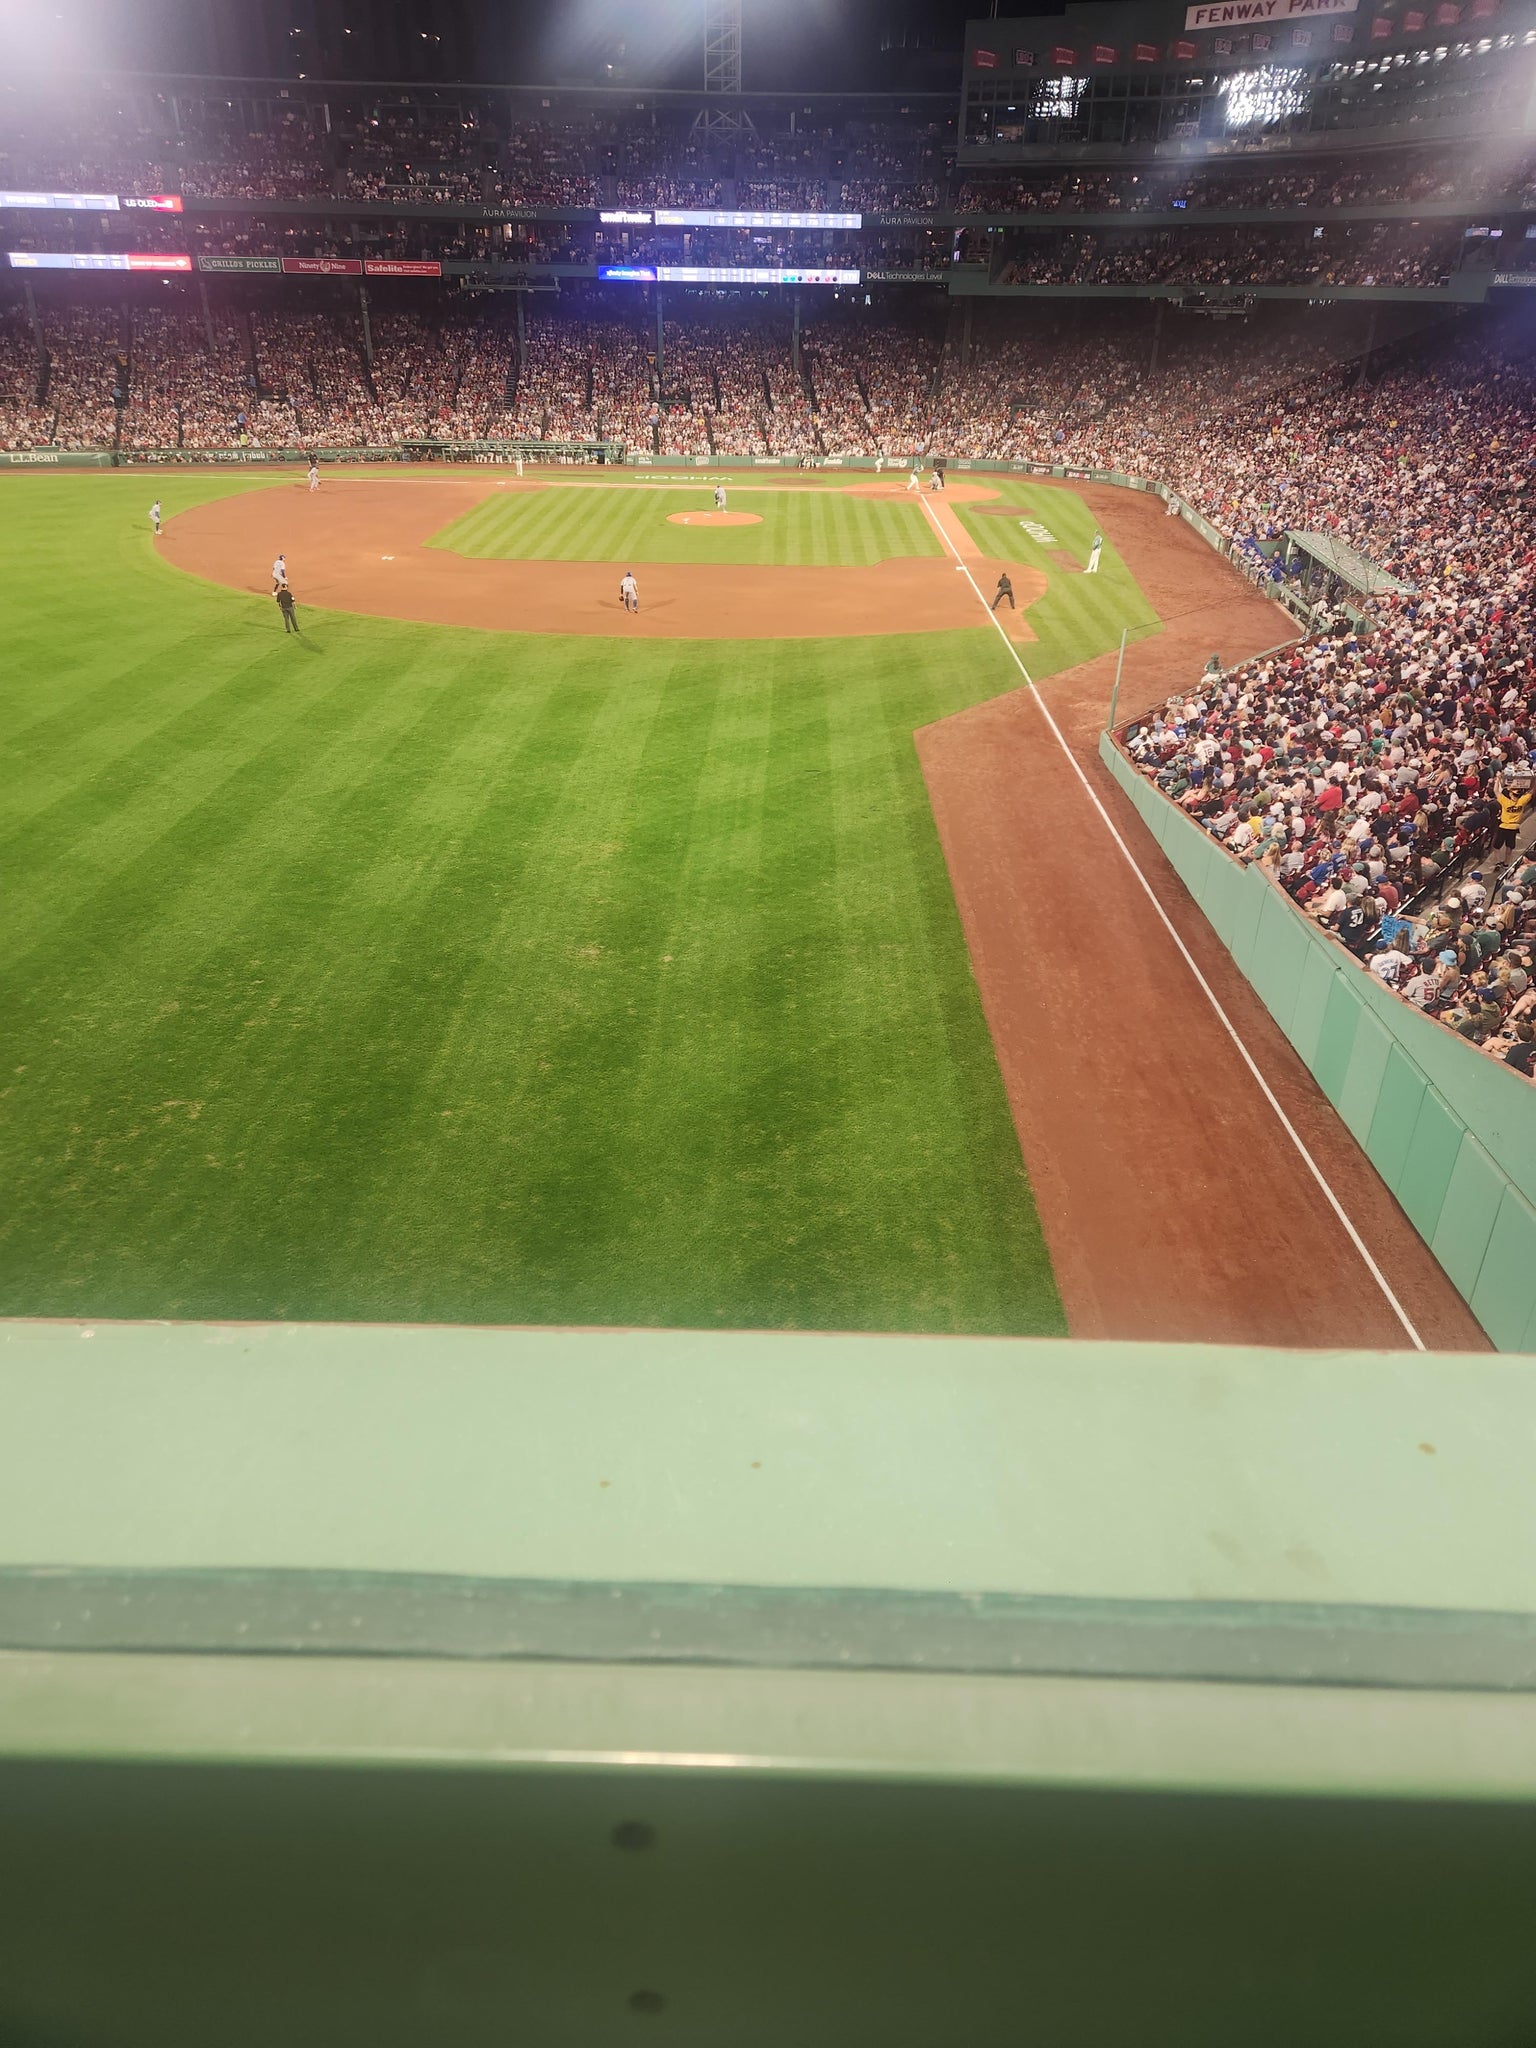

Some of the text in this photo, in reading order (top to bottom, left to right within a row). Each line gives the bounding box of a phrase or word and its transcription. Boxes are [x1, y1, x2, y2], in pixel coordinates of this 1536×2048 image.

[1195, 1, 1276, 24] FENWAY
[506, 210, 537, 218] PAVILION
[903, 217, 934, 225] PAVILION
[212, 260, 278, 269] GRILLO'S PICKLES
[299, 262, 320, 270] Ninety
[367, 264, 403, 273] Safelite
[867, 272, 943, 281] DELL Technologies Level
[10, 453, 59, 463] L.L.Bean
